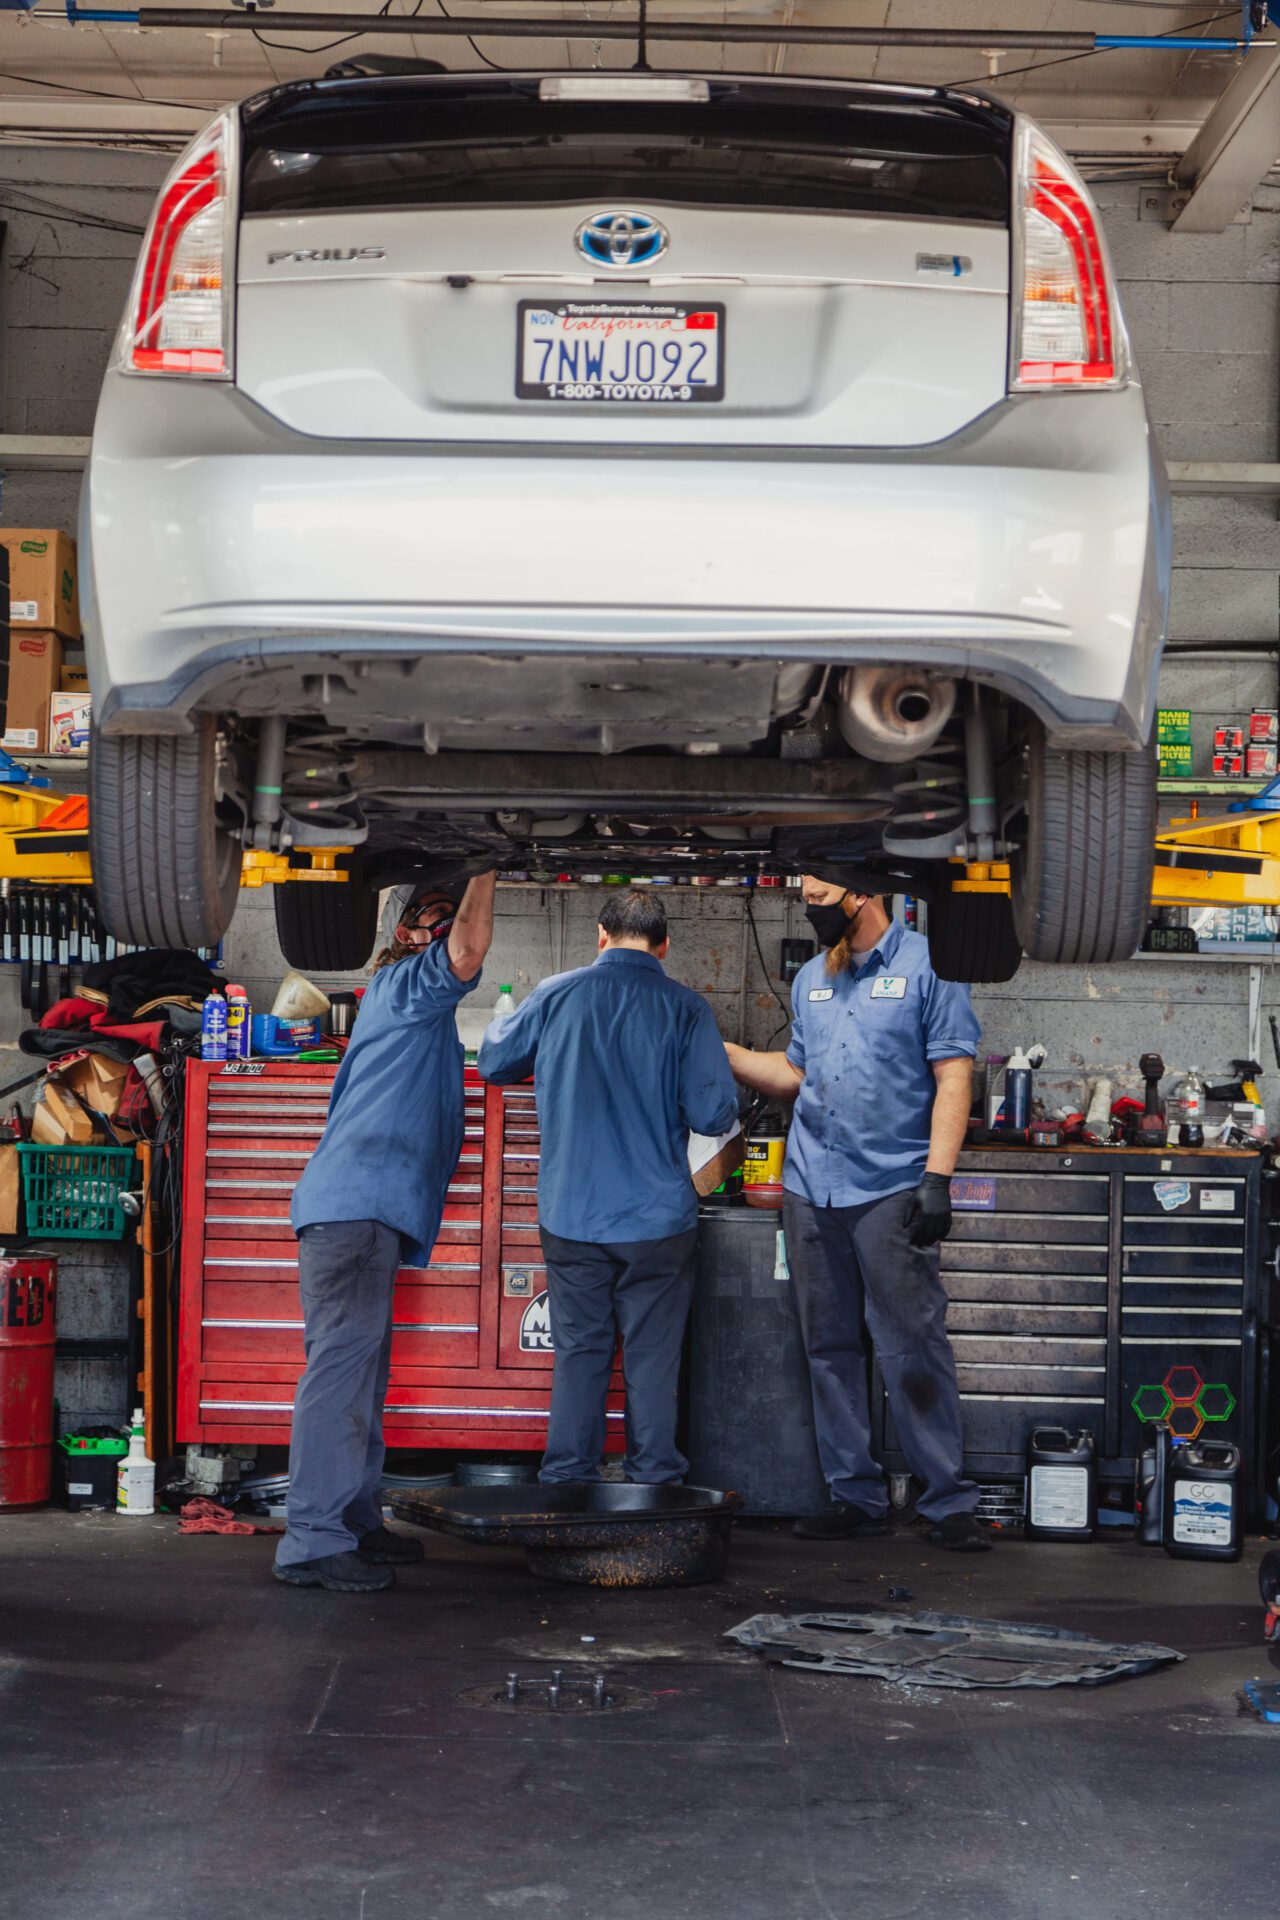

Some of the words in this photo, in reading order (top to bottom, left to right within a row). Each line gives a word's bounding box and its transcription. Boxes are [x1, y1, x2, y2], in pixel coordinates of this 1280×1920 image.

[266, 247, 386, 264] PRIUS
[566, 304, 676, 315] ToyotaSunnyvale.com
[530, 313, 555, 325] NOV
[562, 315, 685, 337] California
[533, 338, 707, 384] 7NWJ092
[547, 385, 692, 399] 1-800-TOYOTA-9
[1158, 711, 1190, 719] MANN
[0, 1277, 45, 1327] ED
[1190, 1484, 1216, 1498] GC
